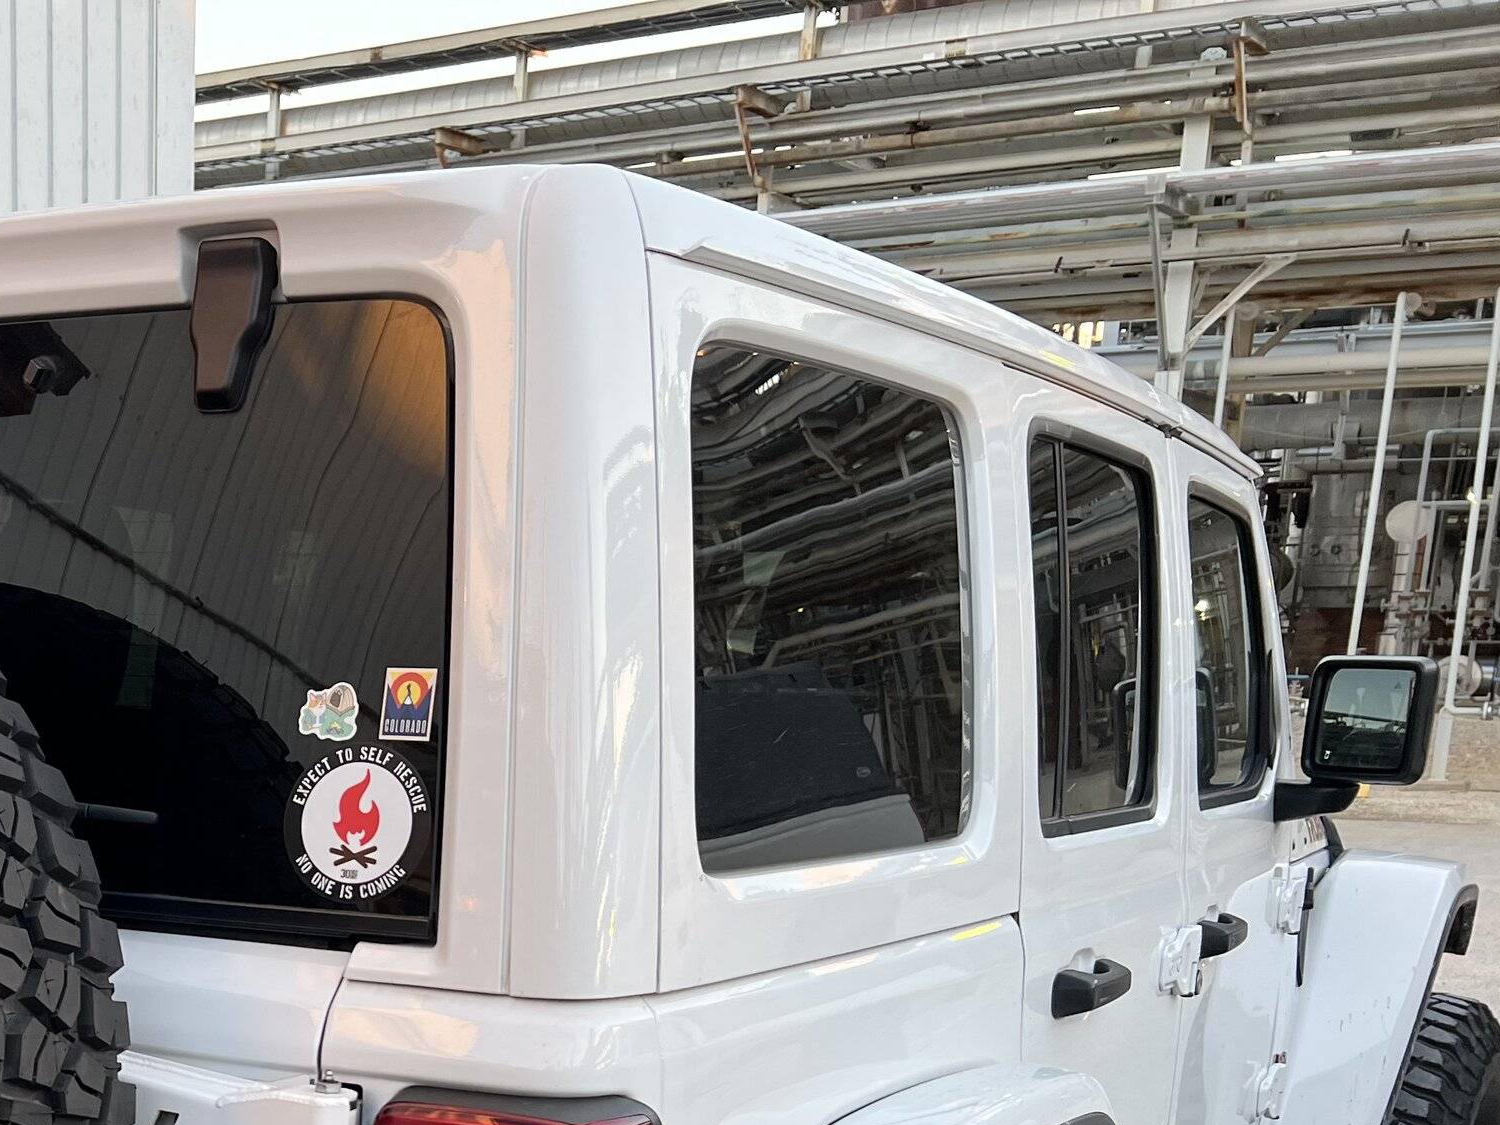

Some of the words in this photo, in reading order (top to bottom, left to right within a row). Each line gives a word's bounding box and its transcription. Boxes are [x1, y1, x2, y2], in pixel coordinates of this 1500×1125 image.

[384, 718, 427, 734] COLORADO
[293, 757, 331, 805] EXPECT
[336, 747, 353, 764] TO
[360, 746, 393, 765] SELF
[393, 761, 426, 813] RESCUE
[295, 853, 313, 874] NO
[311, 872, 336, 895] ONE
[340, 884, 353, 899] IS
[359, 864, 406, 899] COMING
